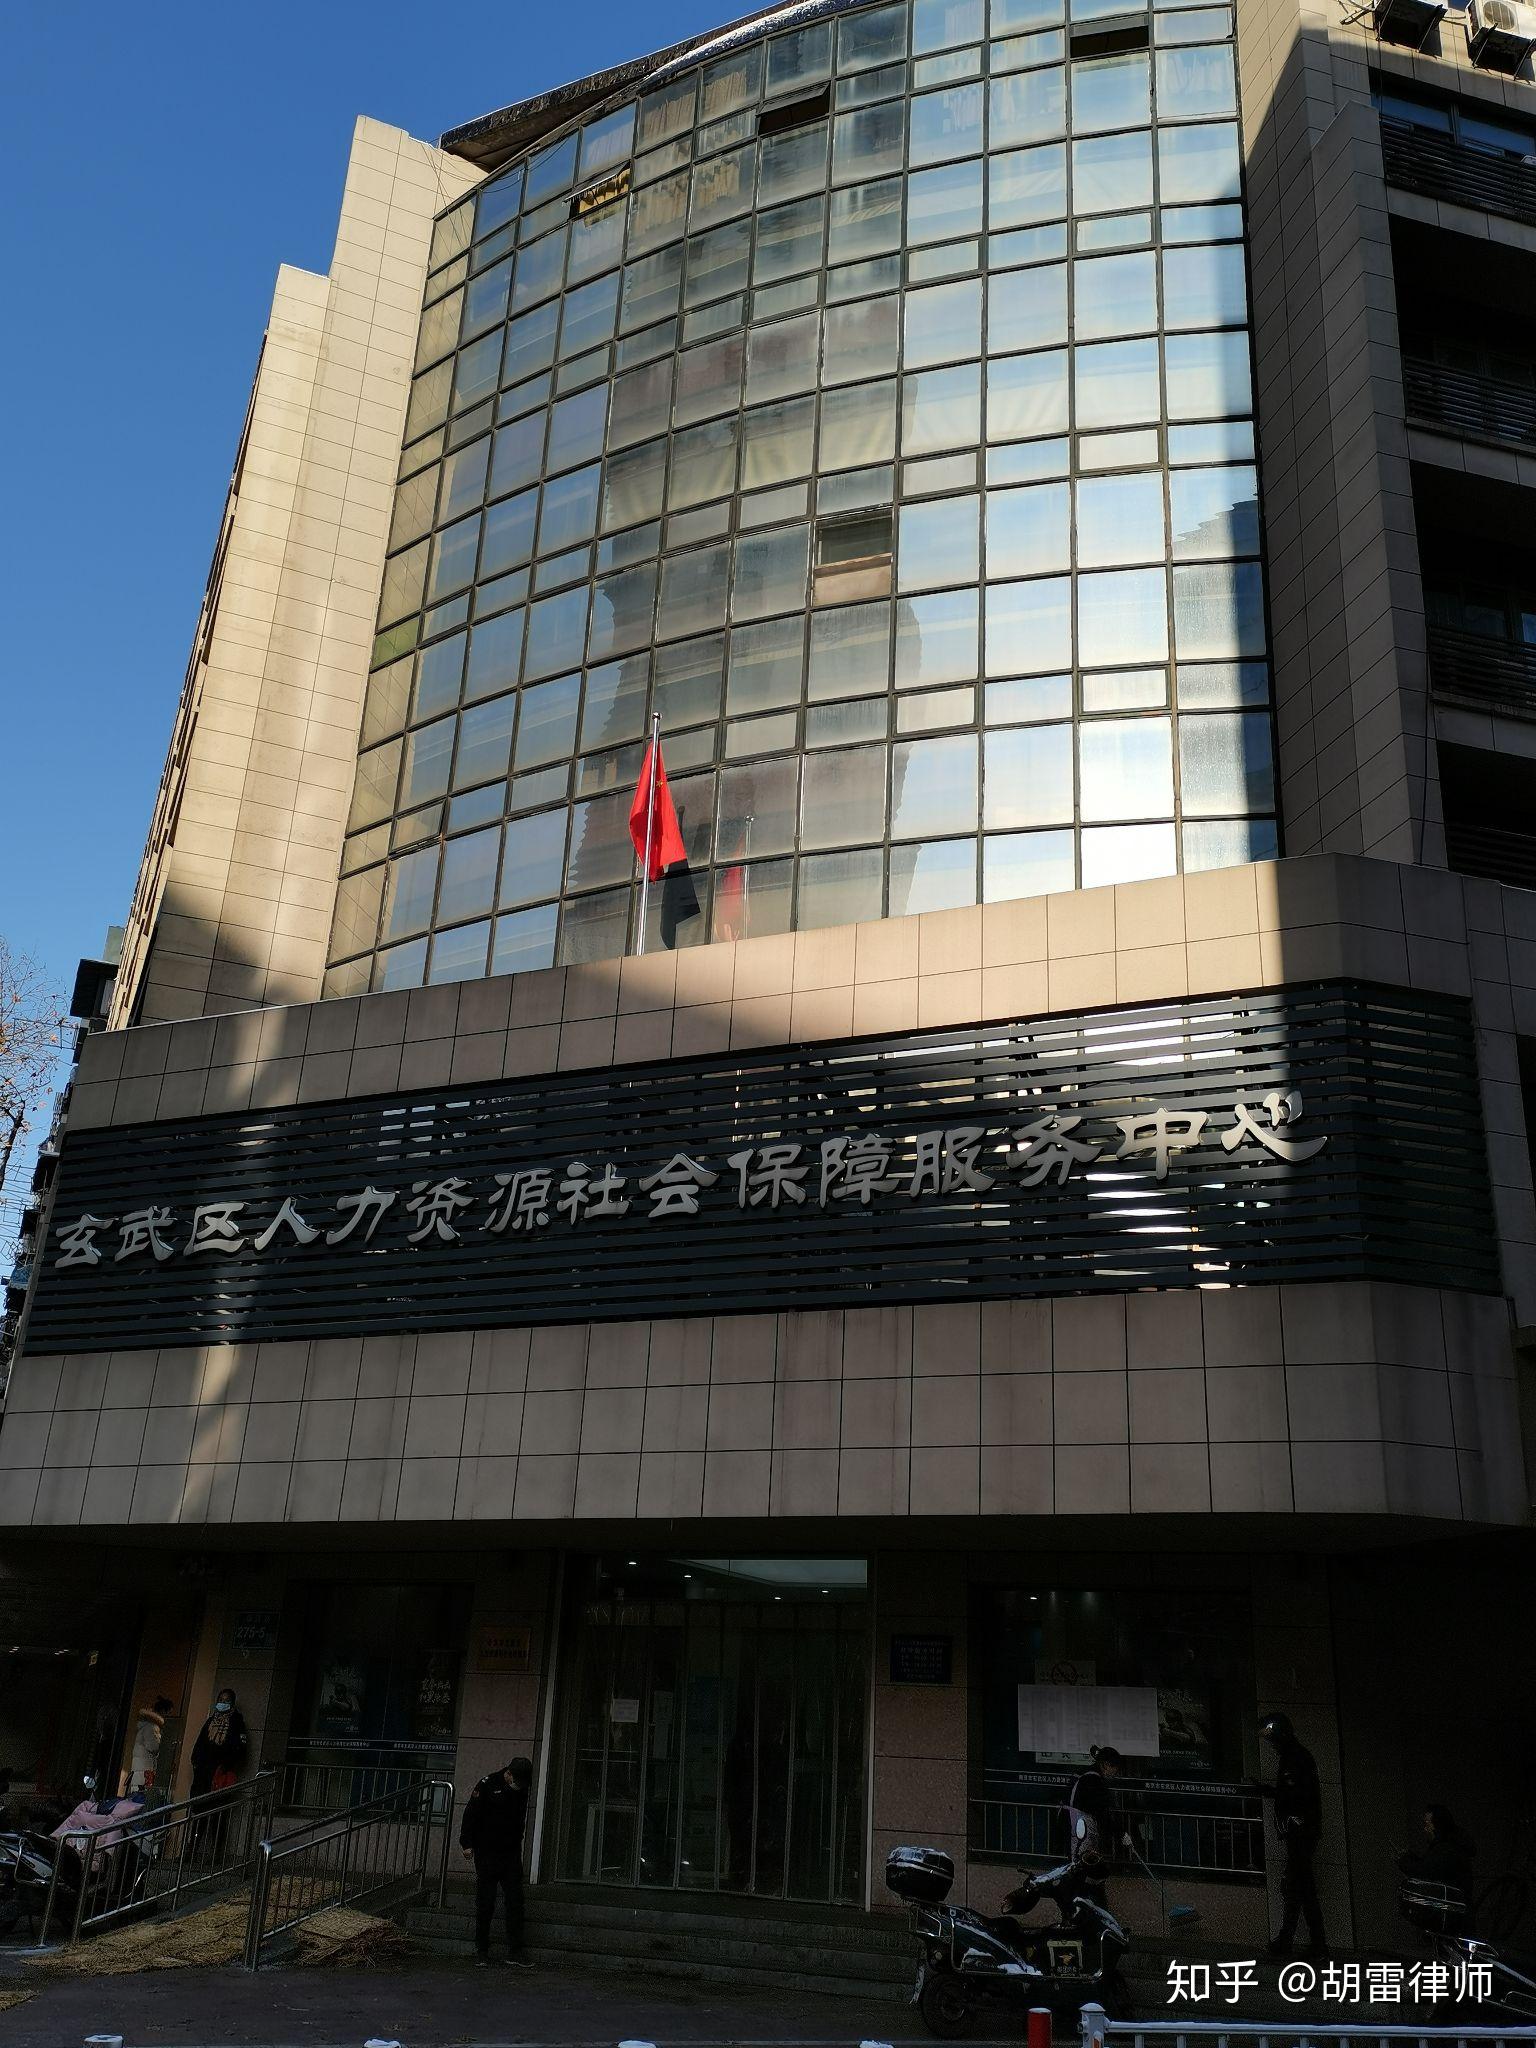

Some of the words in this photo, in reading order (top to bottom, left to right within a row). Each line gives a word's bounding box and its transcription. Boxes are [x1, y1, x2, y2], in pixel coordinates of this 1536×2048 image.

[55, 1089, 1328, 1268] 玄武区人力资源社会保障服务中心
